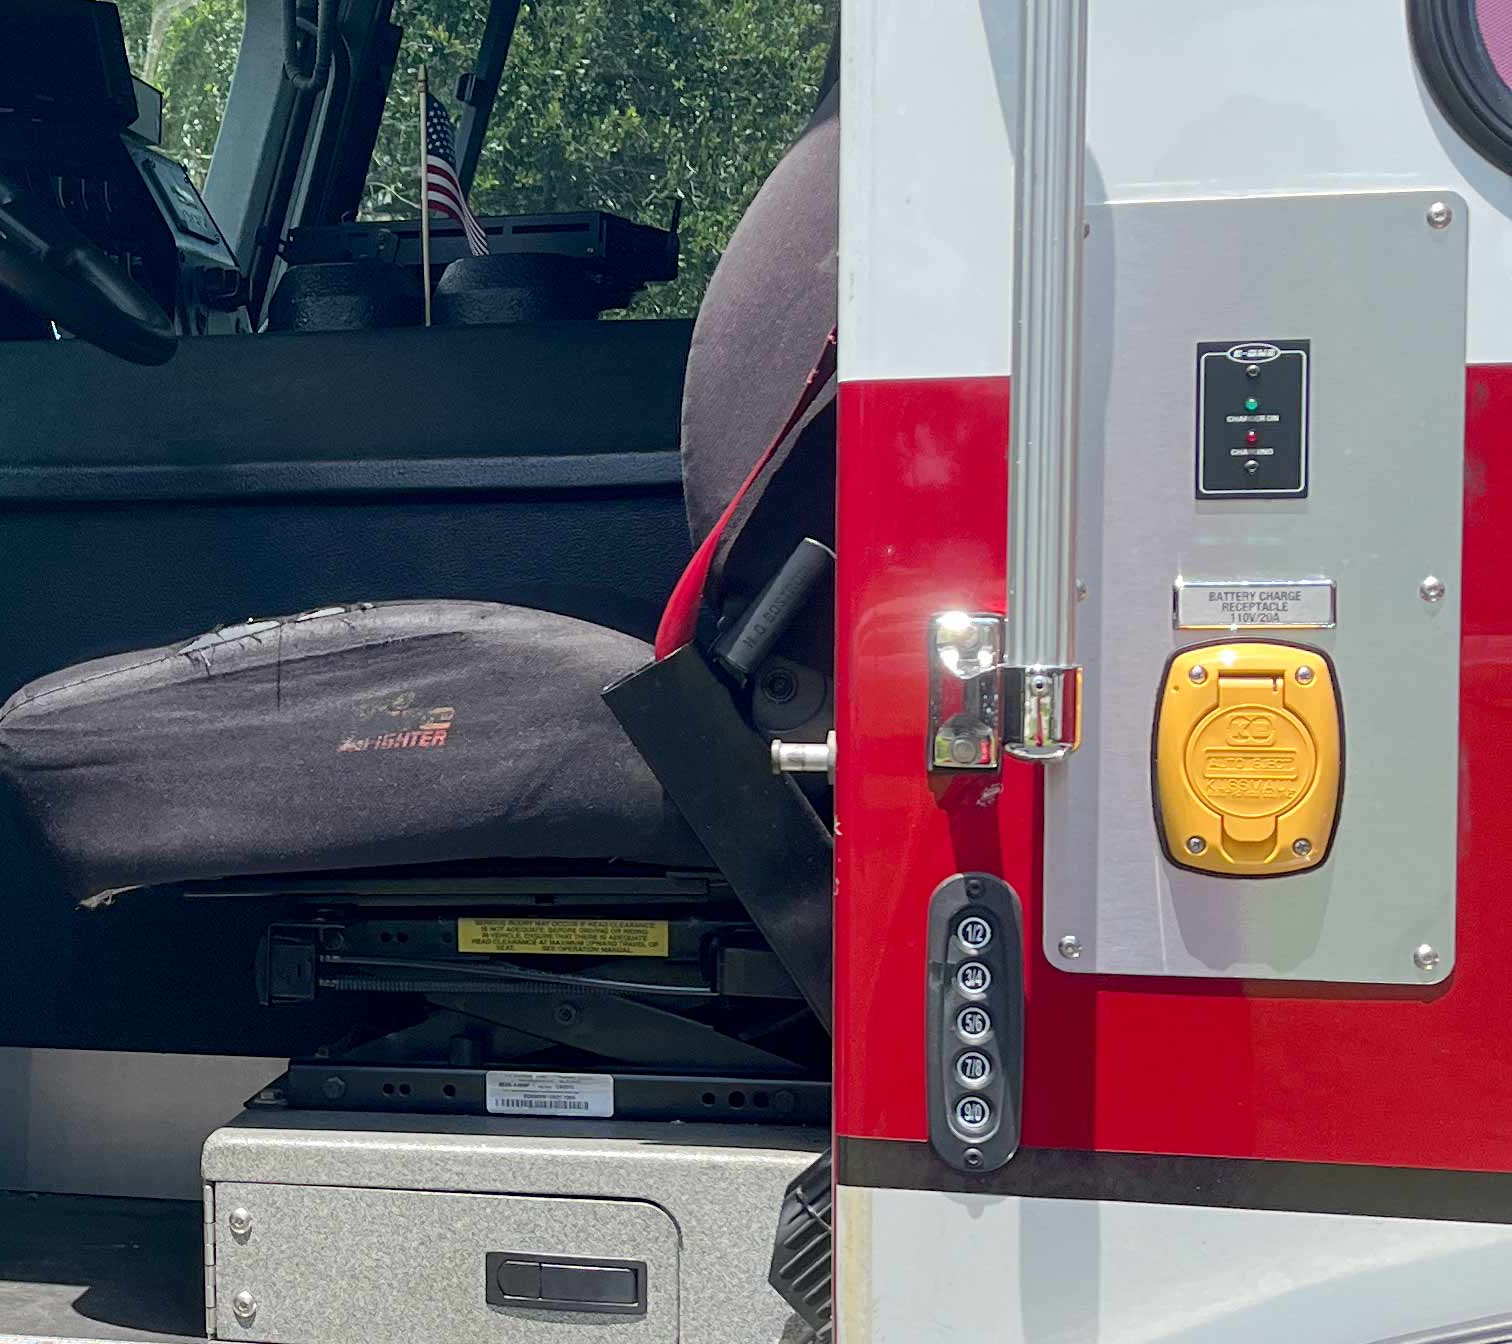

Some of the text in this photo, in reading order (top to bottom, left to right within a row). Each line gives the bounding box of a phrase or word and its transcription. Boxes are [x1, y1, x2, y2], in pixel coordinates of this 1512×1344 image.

[1209, 591, 1301, 602] BATTERY CHARGE
[1222, 602, 1289, 612] RECEPTACLE
[1231, 613, 1280, 623] 110V/20A
[966, 924, 983, 942] 1/2
[965, 969, 983, 987] 3/4
[965, 1013, 982, 1032] 5/6
[964, 1058, 982, 1077] 7/8
[964, 1103, 982, 1121] 9/0
